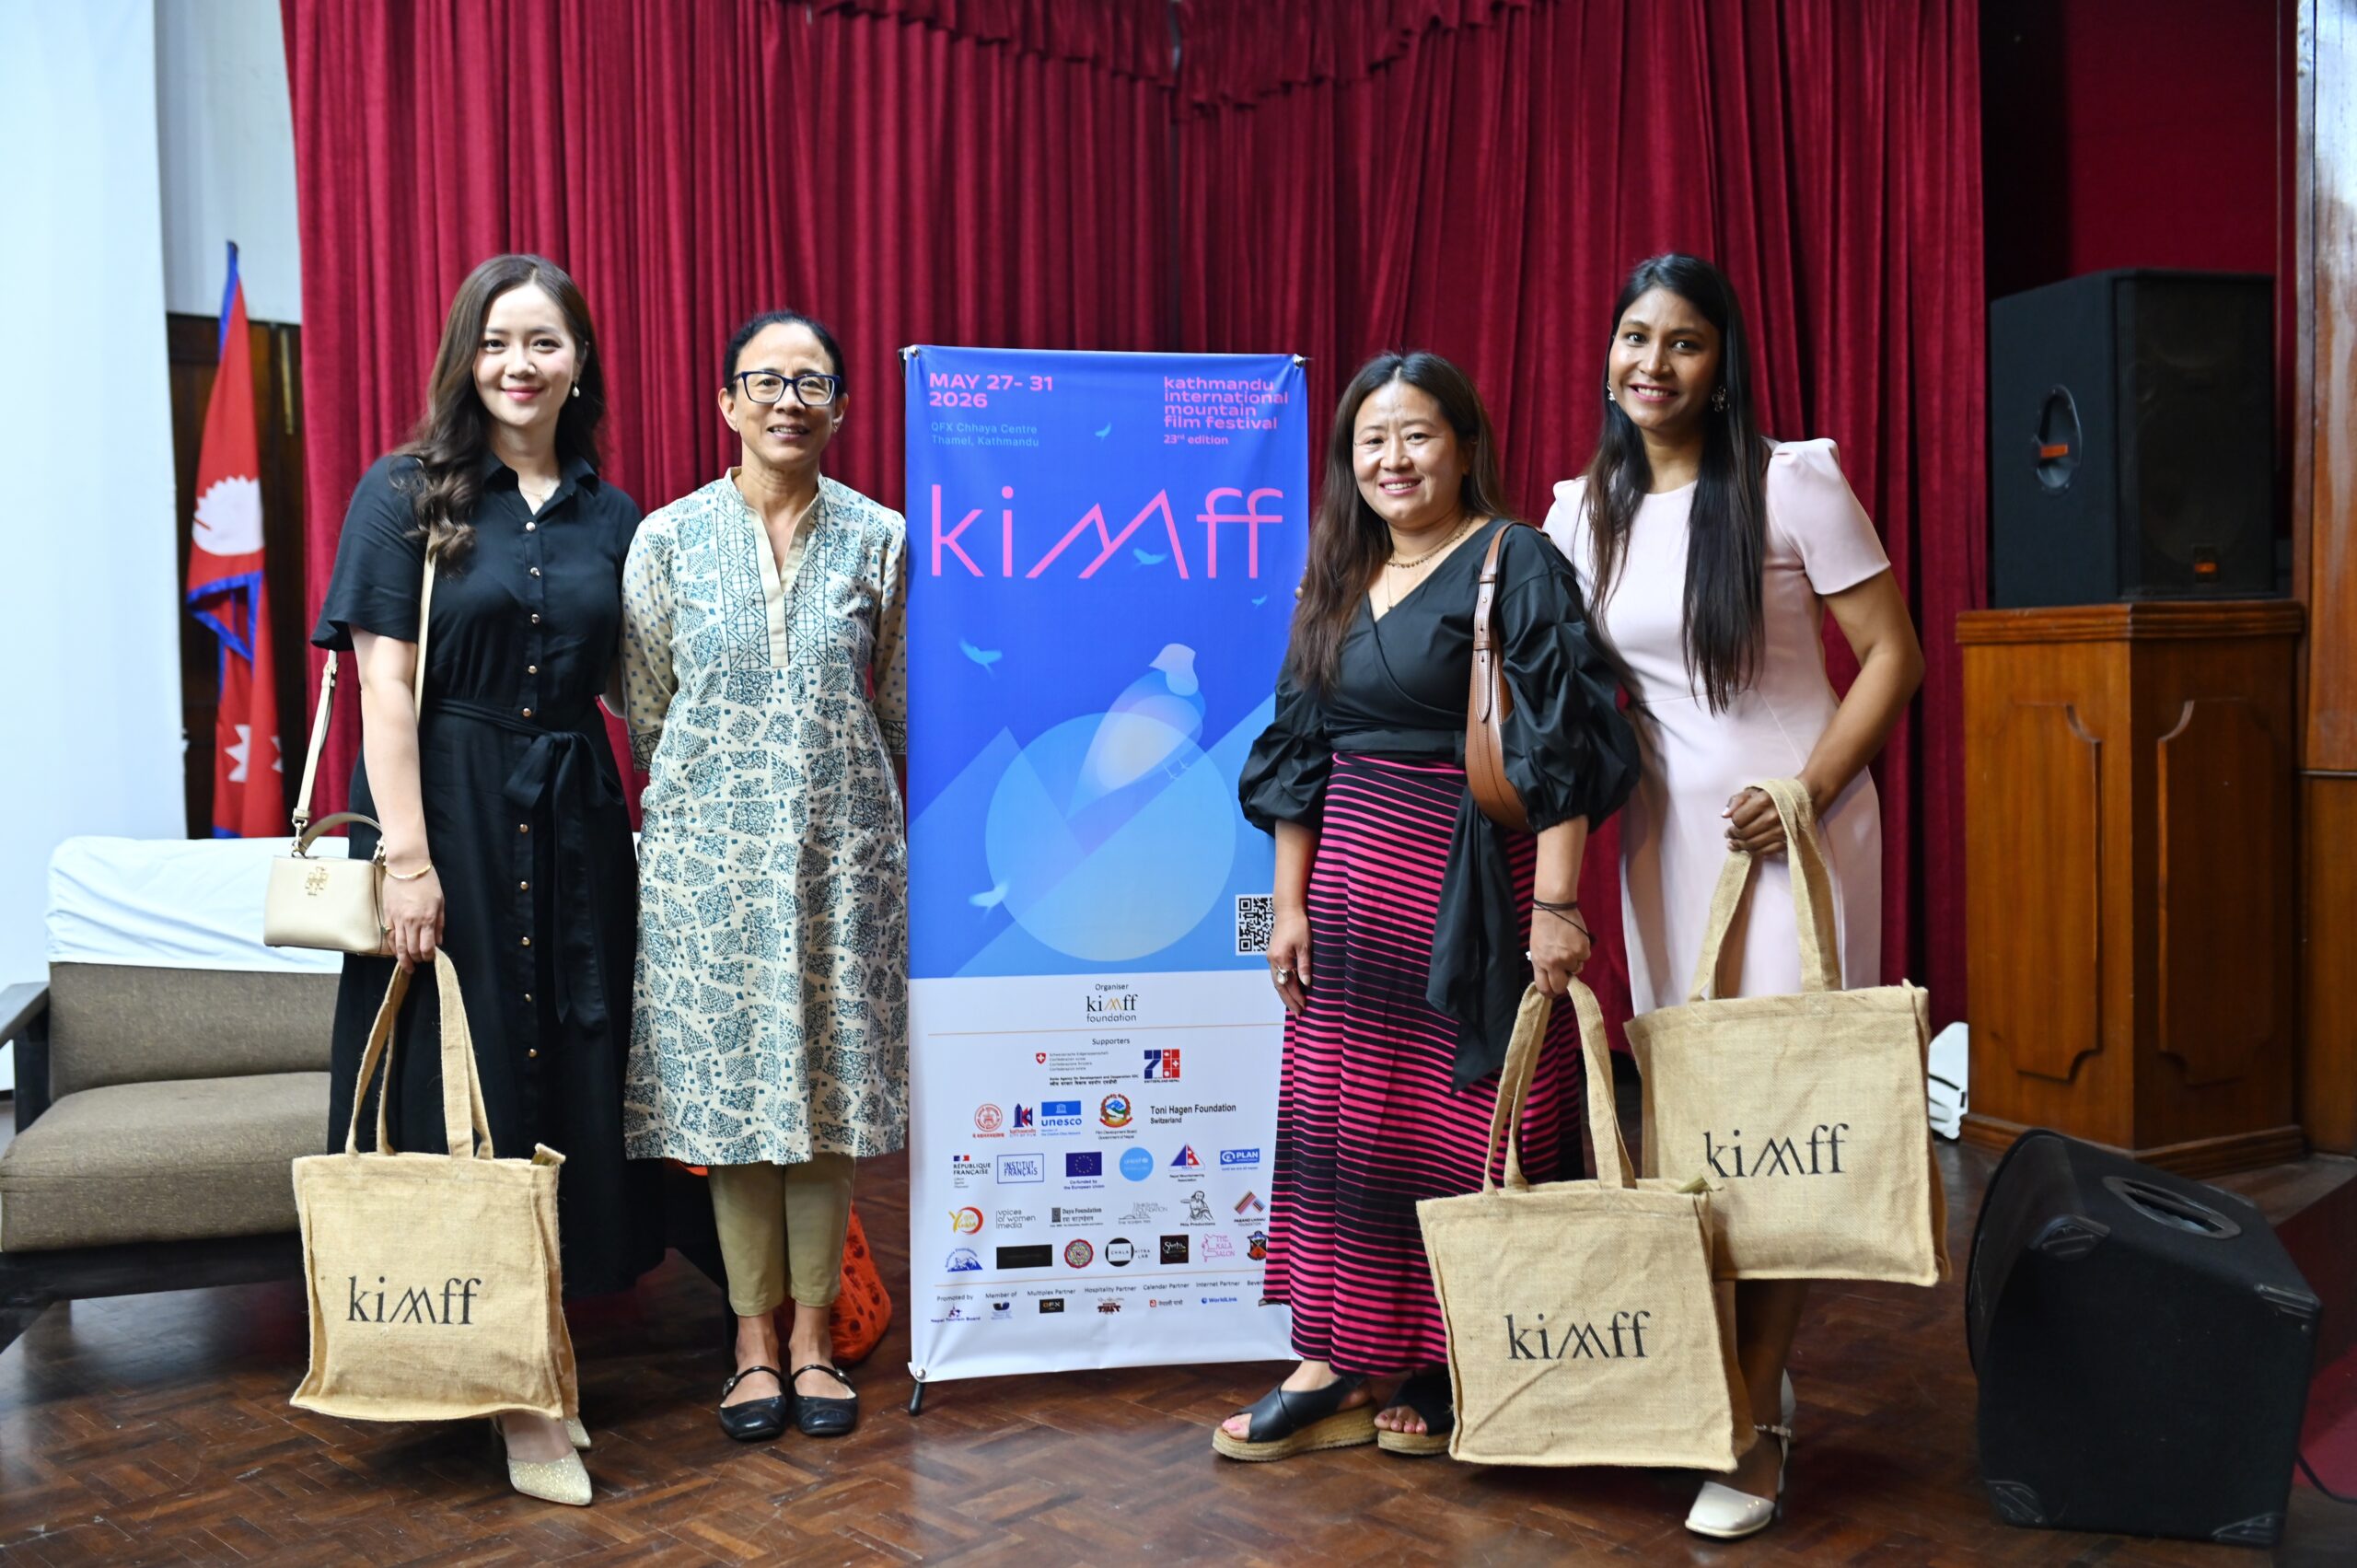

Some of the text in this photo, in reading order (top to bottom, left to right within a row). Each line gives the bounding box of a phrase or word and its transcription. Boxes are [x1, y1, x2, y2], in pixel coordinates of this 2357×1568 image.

[929, 372, 981, 389] MAY
[1029, 375, 1052, 391] 31
[1164, 376, 1274, 391] kathmandu
[929, 390, 988, 408] 2026
[1164, 389, 1288, 404] international
[1164, 403, 1257, 416] mountain
[1164, 414, 1278, 430] film festival
[931, 423, 1038, 435] QFX Chhaya Centre
[978, 436, 1039, 447] Kathmandu
[1188, 436, 1229, 445] edition
[1095, 983, 1129, 992] Organiser
[1086, 1013, 1137, 1023] foundation
[1092, 1038, 1131, 1046] Supporters
[1151, 1104, 1237, 1115] Toni Hagen Foundation
[1041, 1118, 1082, 1126] unesco
[1237, 1151, 1258, 1159] PLAN
[1085, 1285, 1114, 1294] Hospitality
[346, 1275, 482, 1325] kimff
[1504, 1310, 1651, 1361] kimff
